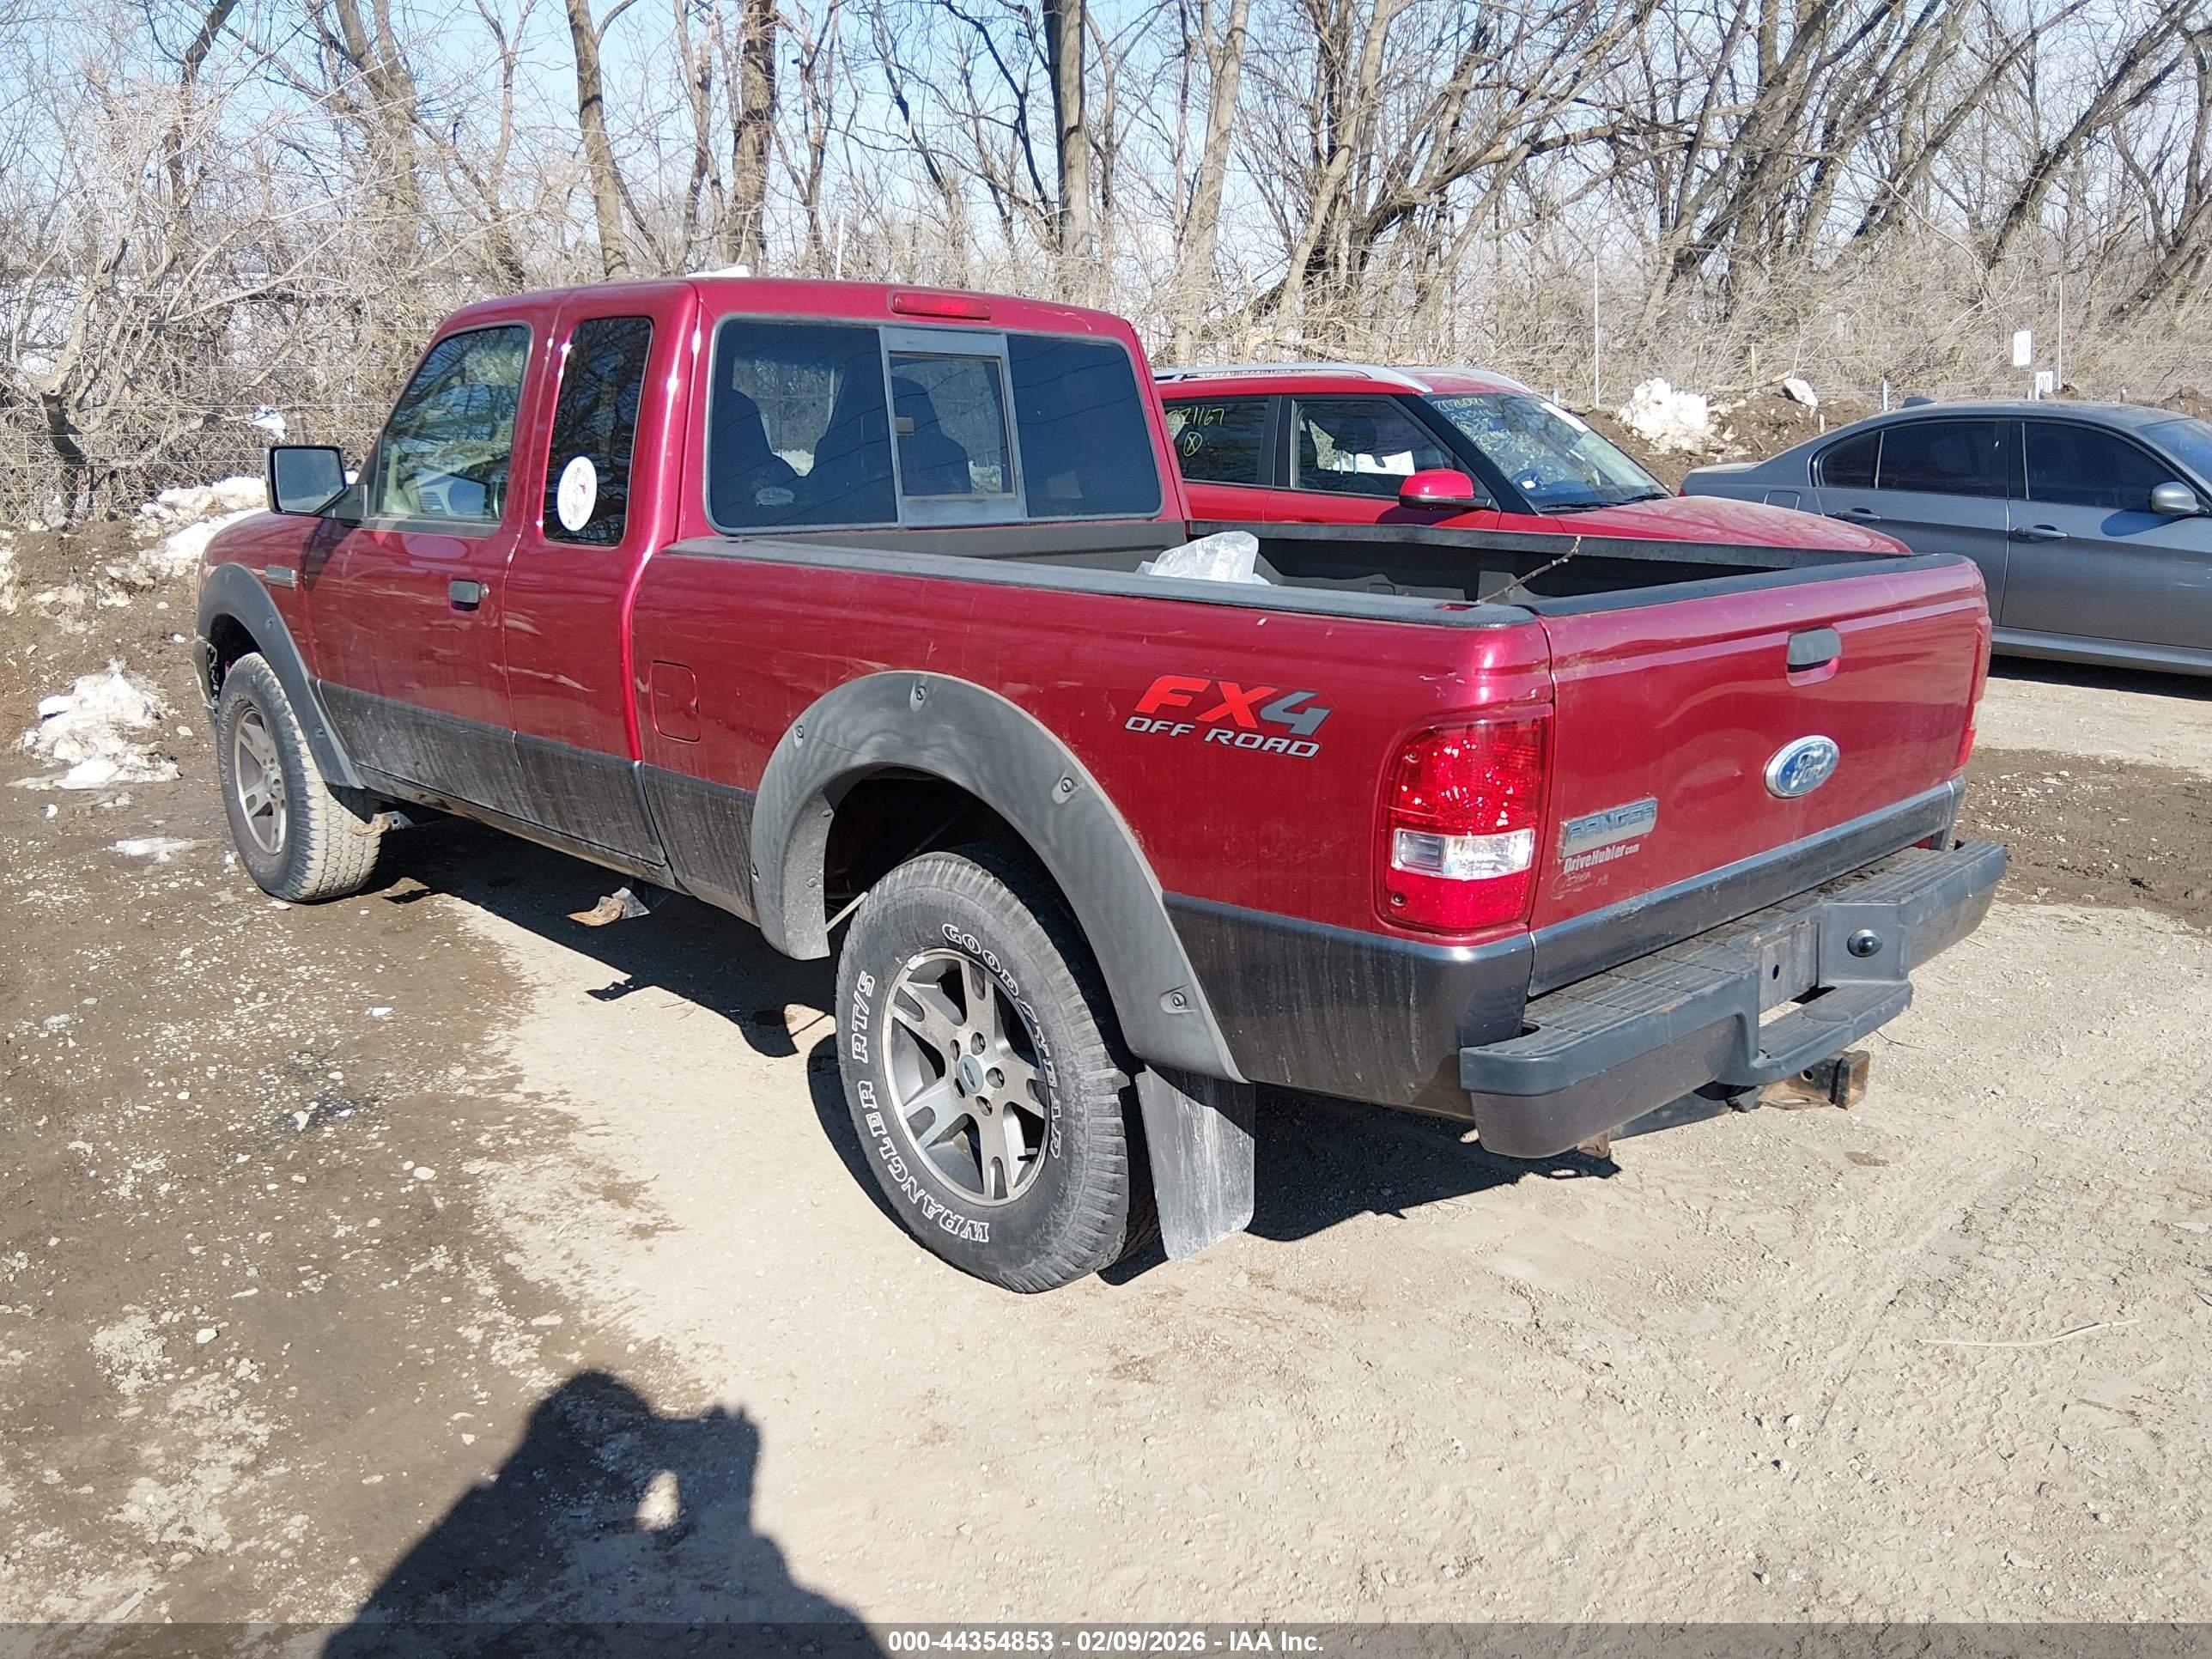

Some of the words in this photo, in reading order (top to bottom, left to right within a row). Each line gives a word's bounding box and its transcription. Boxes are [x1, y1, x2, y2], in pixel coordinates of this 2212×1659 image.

[1134, 674, 1331, 736] FX4
[1124, 715, 1195, 738] OFF
[1204, 727, 1321, 758] ROAD
[1788, 746, 1832, 789] Ford
[1567, 802, 1656, 842] RANGER
[851, 970, 876, 1064] RT/S
[858, 1080, 989, 1243] WRANGLER
